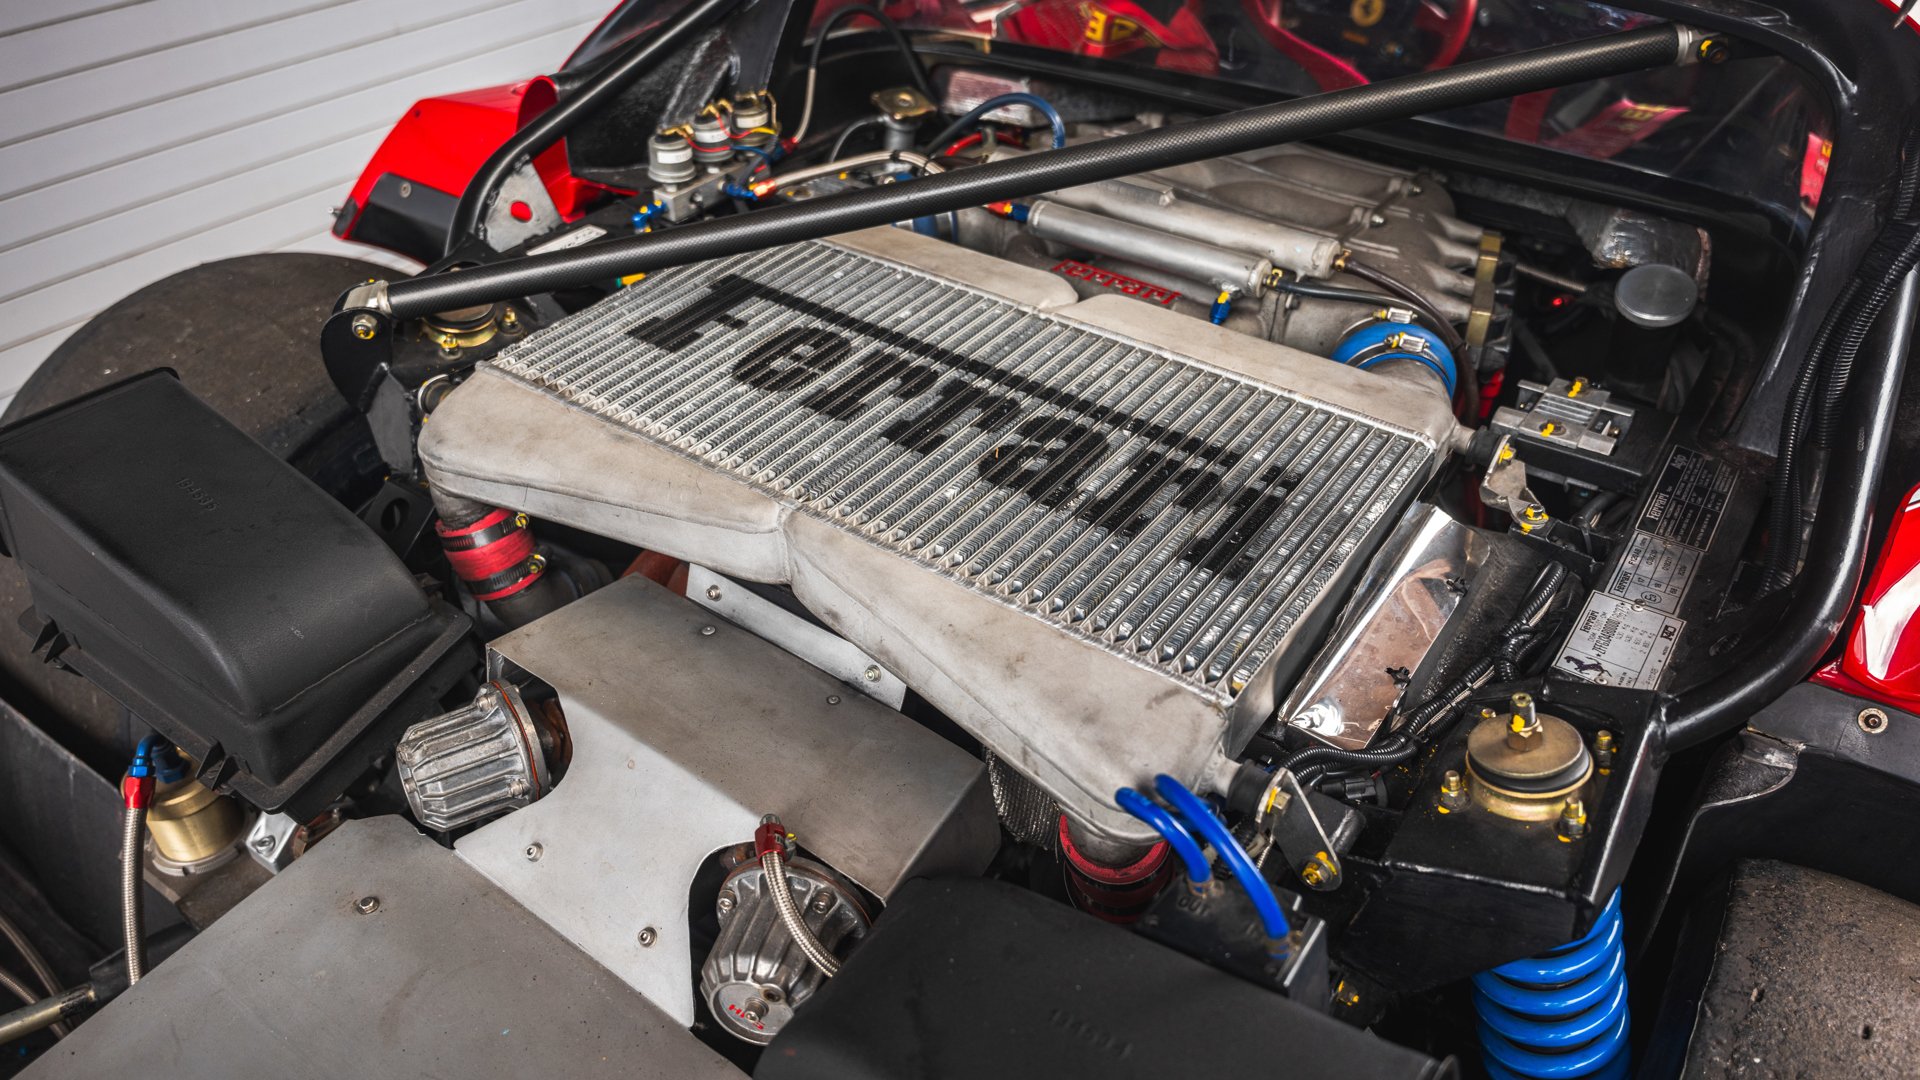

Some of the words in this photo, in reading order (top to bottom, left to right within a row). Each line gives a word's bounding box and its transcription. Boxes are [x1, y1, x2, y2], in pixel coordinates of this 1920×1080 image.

[1052, 258, 1183, 305] Ferrari
[627, 273, 1301, 579] Ferrari
[1646, 492, 1669, 520] Ferrari
[1614, 570, 1632, 593] Ferrari
[1580, 609, 1599, 633] Ferrari
[1660, 625, 1677, 641] F40
